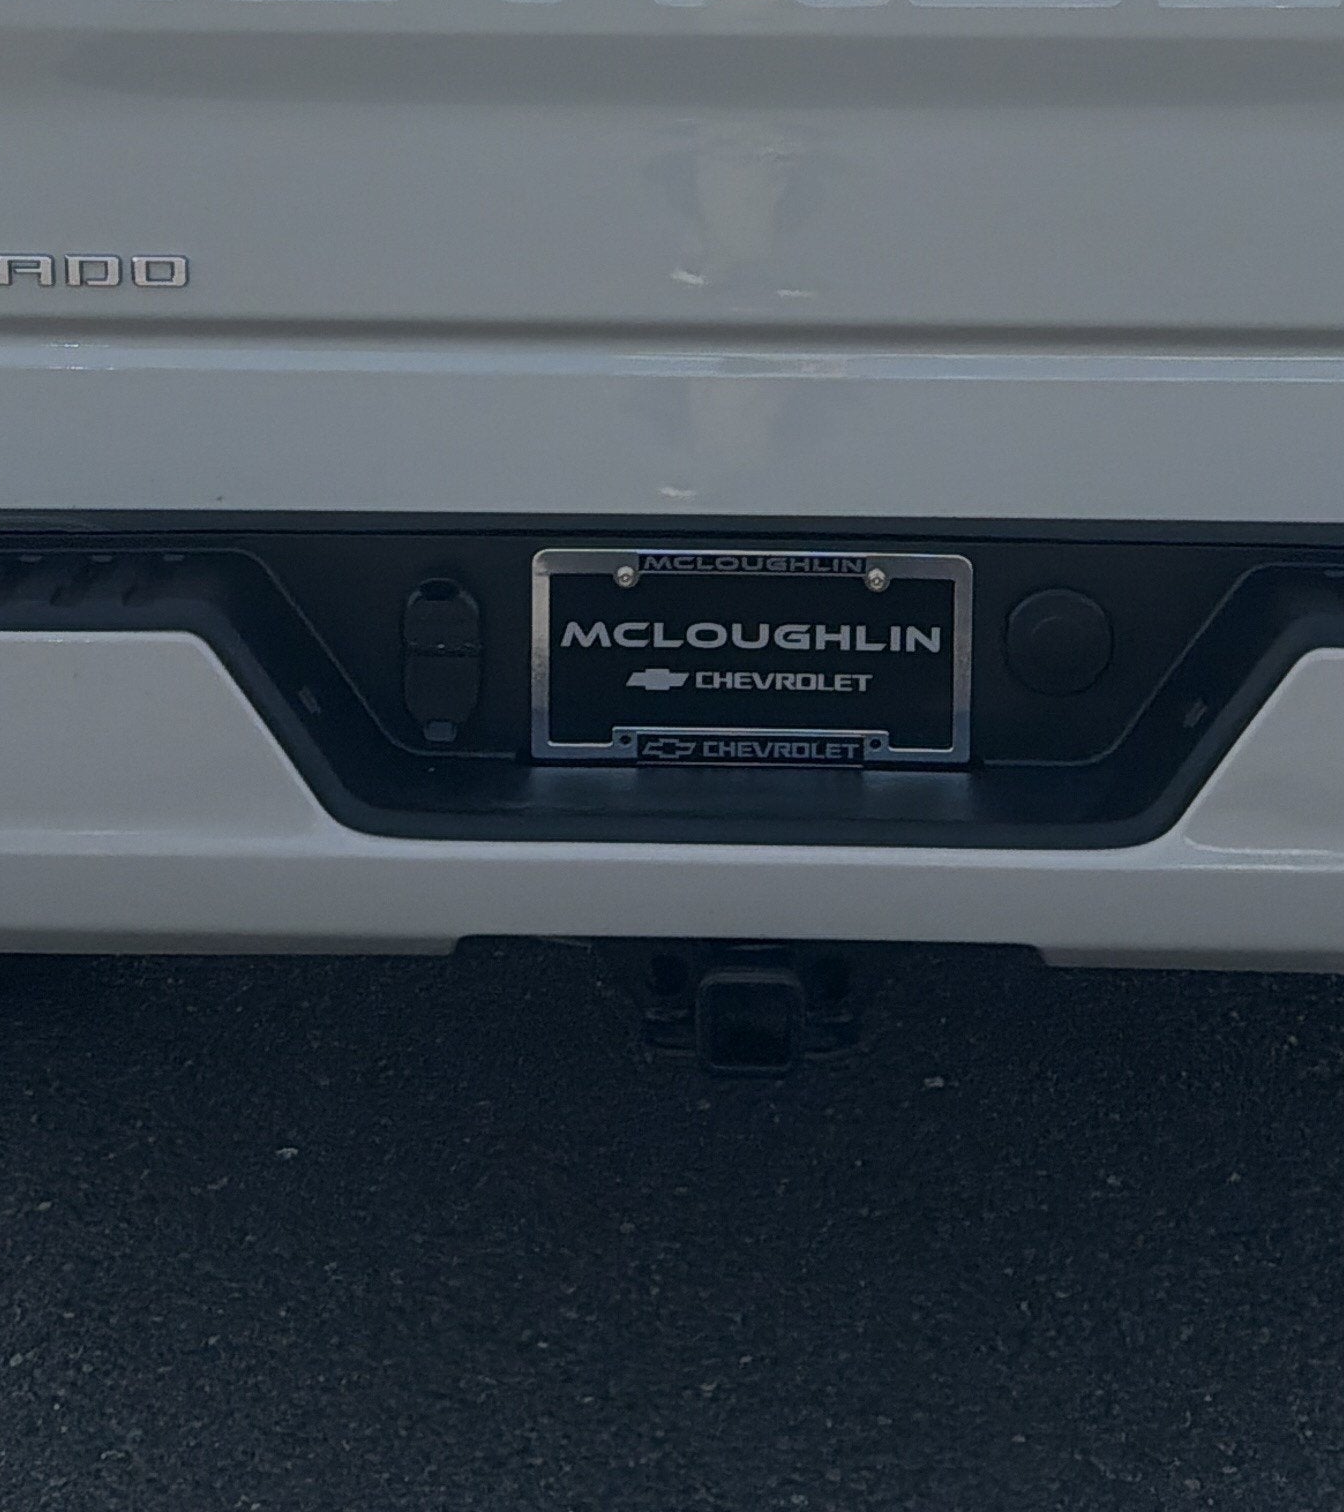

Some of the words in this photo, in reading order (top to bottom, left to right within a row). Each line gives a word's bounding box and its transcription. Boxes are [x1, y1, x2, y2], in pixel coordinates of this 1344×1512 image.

[643, 555, 863, 573] MCLOUGHLIN
[560, 620, 942, 654] MCLOUGHLIN
[694, 671, 873, 692] CHEVROLET
[702, 740, 860, 760] CHEVROLET
